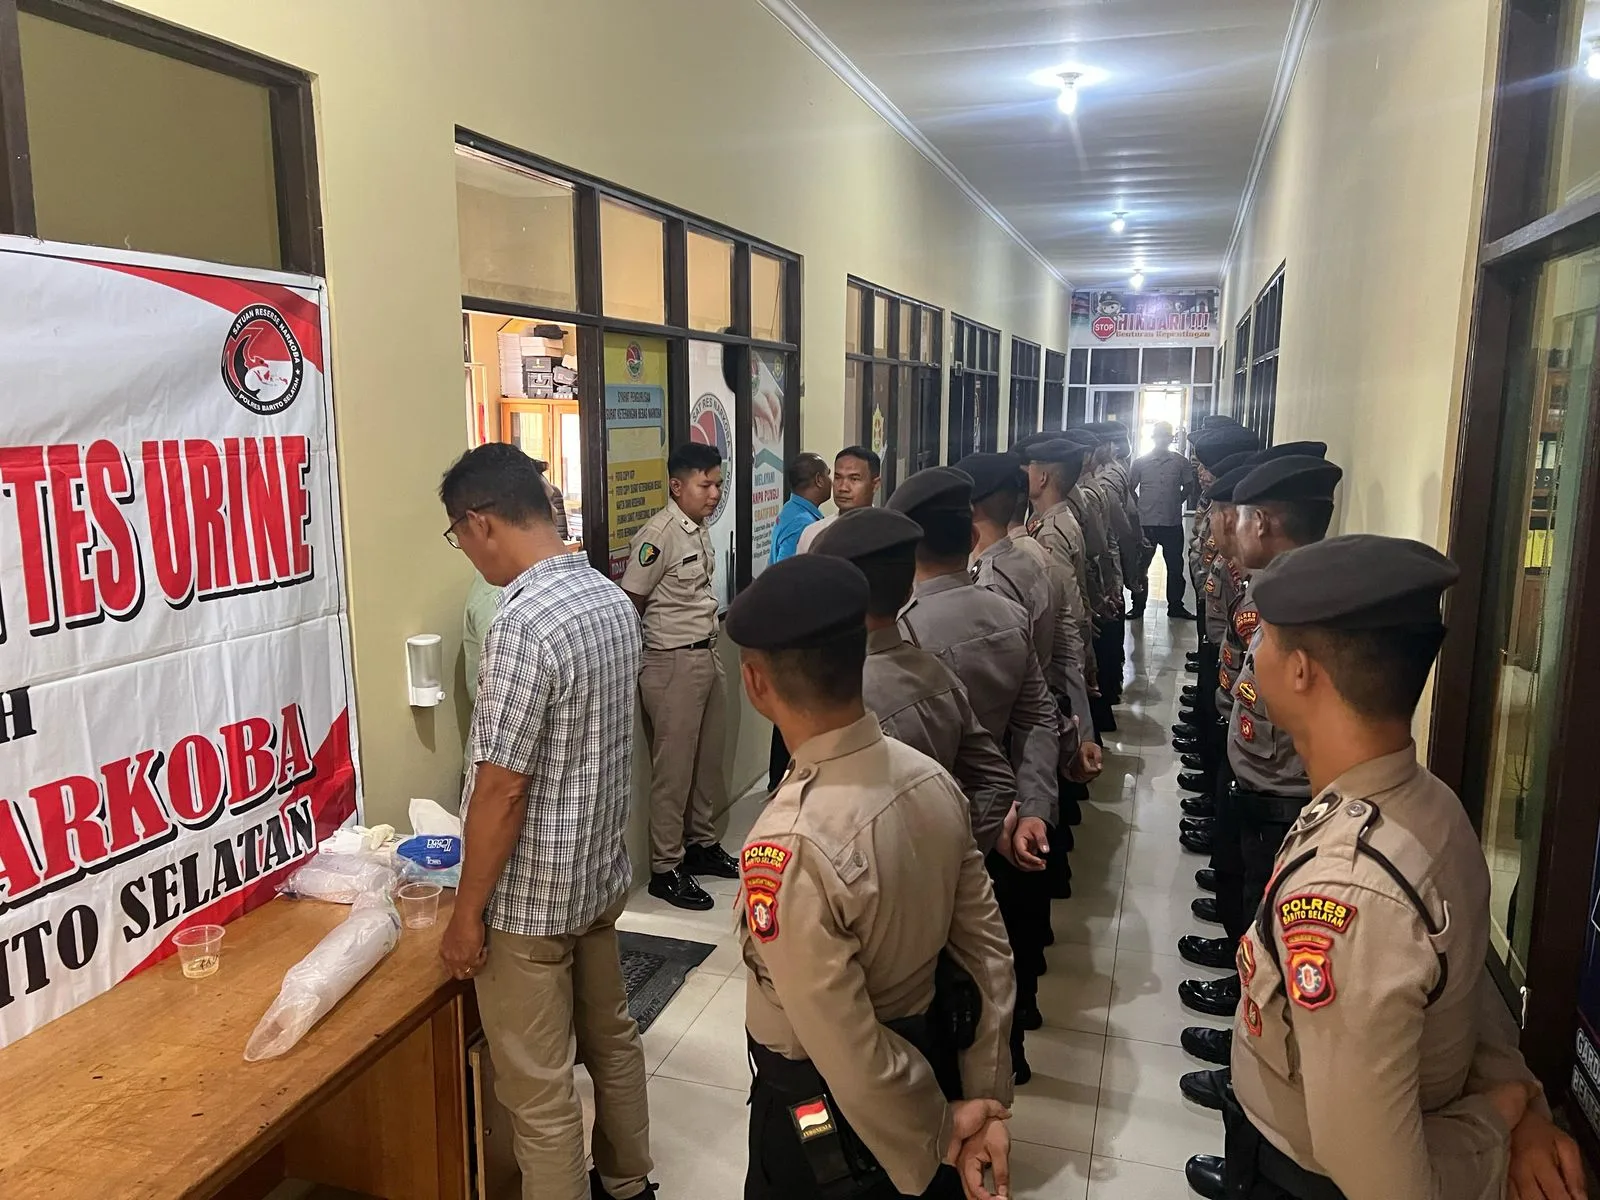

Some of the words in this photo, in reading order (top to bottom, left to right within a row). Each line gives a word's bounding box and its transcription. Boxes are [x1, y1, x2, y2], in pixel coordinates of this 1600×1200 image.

[233, 310, 255, 335] SATUAN
[255, 308, 281, 326] RESERSE
[278, 324, 301, 364] NARKOBA
[1095, 323, 1114, 332] STOP
[239, 394, 261, 411] POLRES
[262, 401, 284, 412] BARITO
[283, 378, 300, 405] SELATAN
[692, 402, 703, 423] SAT
[702, 397, 713, 410] RES
[0, 438, 143, 632] TES
[142, 435, 313, 607] URINE
[745, 846, 786, 863] POLRES
[120, 798, 312, 943] SELATAN
[1281, 898, 1347, 919] POLRES
[1283, 910, 1306, 926] BARITO
[1308, 910, 1345, 928] SELATAN
